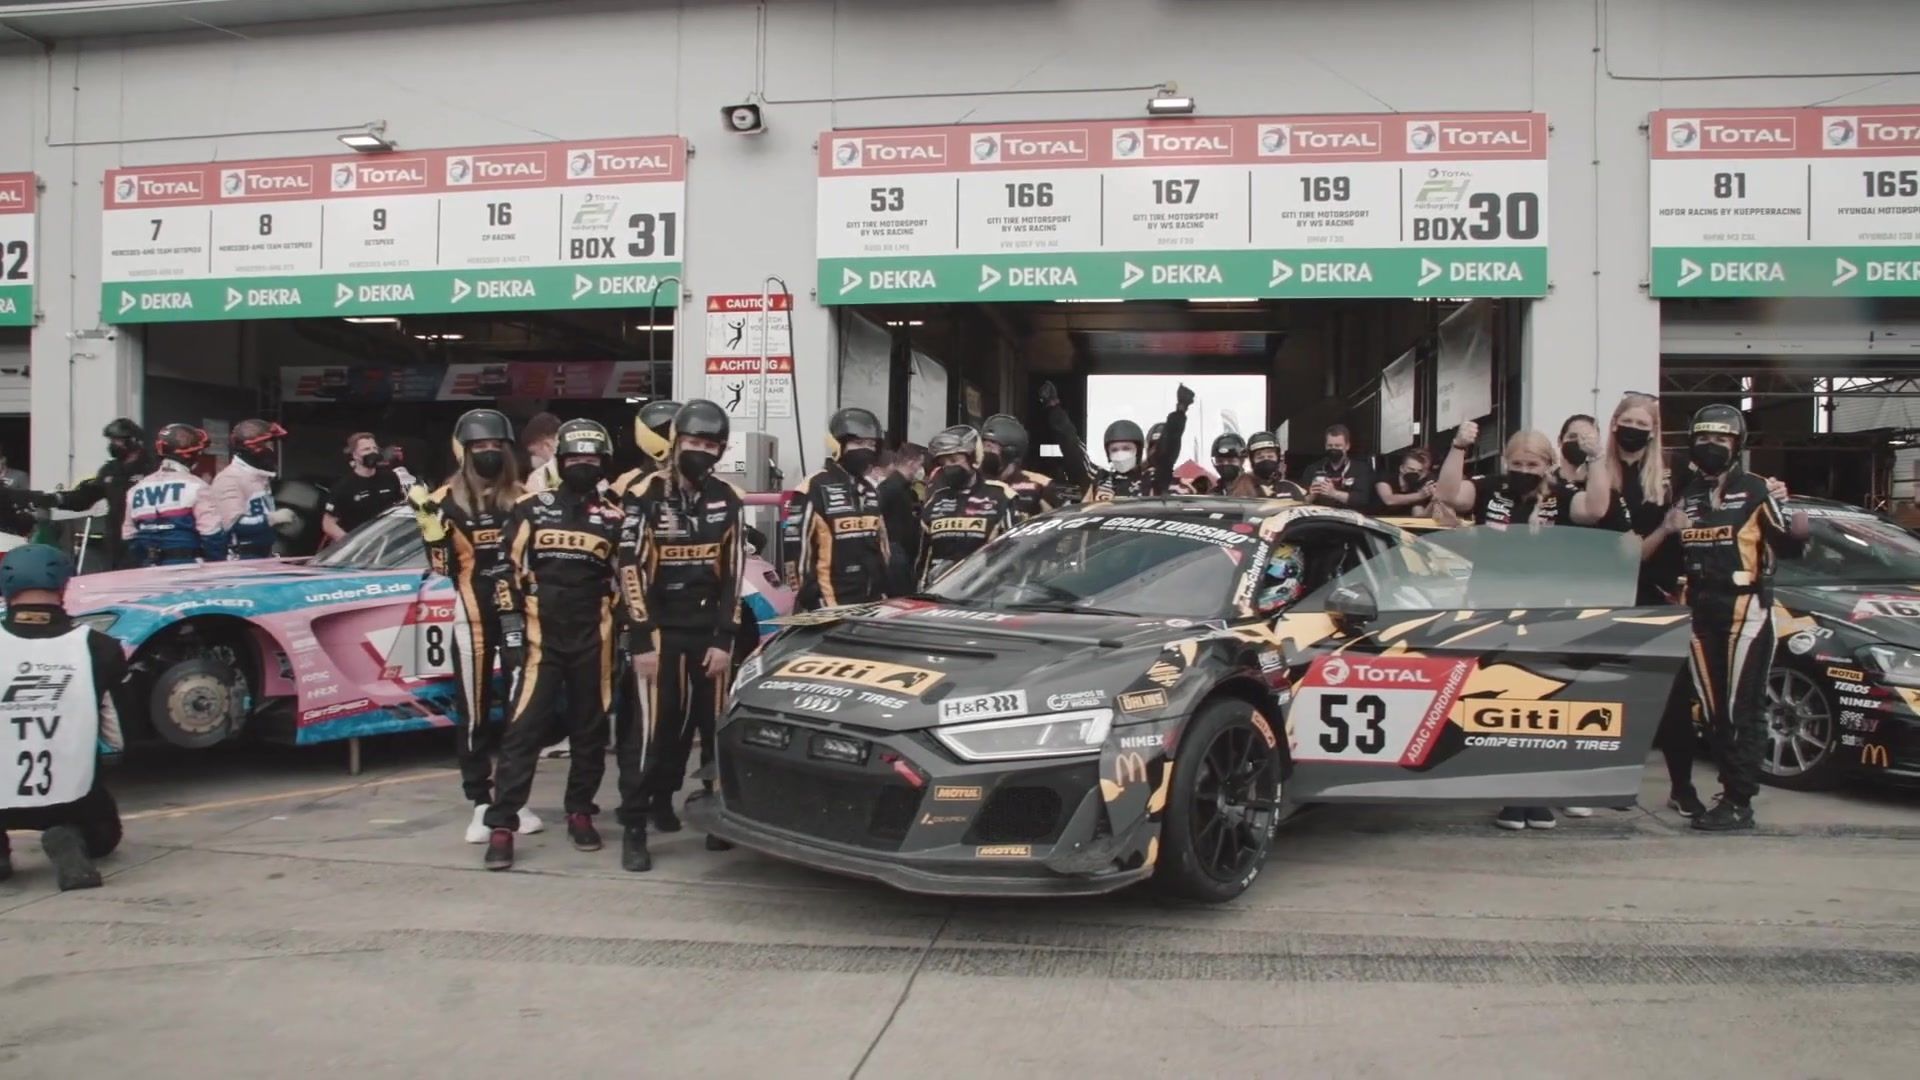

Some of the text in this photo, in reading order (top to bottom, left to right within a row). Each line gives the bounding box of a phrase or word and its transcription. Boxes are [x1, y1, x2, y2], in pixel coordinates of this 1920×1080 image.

[1147, 134, 1229, 151] TOTAL
[1294, 130, 1376, 148] TOTAL
[1443, 127, 1527, 145] TOTAL
[1704, 125, 1790, 144] TOTAL
[865, 143, 943, 161] TOTAL
[1004, 138, 1083, 157] TOTAL
[476, 160, 542, 177] TOTAL
[597, 153, 668, 171] TOTAL
[247, 174, 309, 190] TOTAL
[359, 167, 424, 183] TOTAL
[1441, 169, 1472, 177] TOTAL
[140, 180, 200, 195] TOTAL
[1152, 179, 1200, 204] 167
[1300, 176, 1350, 202] 169
[1714, 172, 1746, 198] 81
[1863, 171, 1918, 198] 165
[870, 187, 904, 212] 53
[1004, 182, 1054, 208] 166
[373, 208, 387, 231] 9
[487, 202, 512, 226] 16
[1021, 215, 1071, 224] MOTORSPORT
[1149, 213, 1165, 221] TIRE
[1168, 212, 1219, 220] MOTORSPORT
[1317, 210, 1369, 218] MOTORSPORT
[1413, 192, 1539, 241] BOX 30
[1659, 207, 1802, 216] HOFOR RACING BY KUEPPERRACING
[1838, 207, 1876, 215] HYUNDAI
[151, 218, 163, 241] 7
[259, 213, 272, 236] 8
[872, 228, 885, 236] WS
[886, 228, 914, 236] RACING
[879, 219, 928, 228] MOTORSPORT
[1028, 224, 1057, 232] RACING
[1175, 221, 1205, 229] RACING
[1325, 219, 1354, 227] RACING
[492, 233, 516, 241] RACING
[570, 212, 676, 260] BOX 31
[0, 240, 28, 280] 2
[869, 269, 936, 289] DEKRA
[1009, 266, 1077, 286] DEKRA
[1152, 264, 1223, 284] DEKRA
[1301, 262, 1373, 282] DEKRA
[1450, 261, 1523, 281] DEKRA
[1710, 262, 1785, 281] DEKRA
[359, 284, 415, 302] DEKRA
[477, 279, 536, 299] DEKRA
[599, 275, 661, 294] DEKRA
[141, 290, 193, 311] DEKRA
[248, 288, 301, 307] DEKRA
[720, 360, 778, 371] ACHTUG
[132, 482, 186, 509] BWT
[839, 519, 868, 530] Giti
[933, 520, 963, 531] Giti
[1103, 516, 1249, 544] GRAN TURISMO
[539, 533, 585, 546] Giti
[1178, 532, 1235, 549] SIMULATOR
[1683, 530, 1711, 540] Giti
[664, 548, 702, 558] Giti
[304, 582, 413, 603] under8.de
[160, 598, 255, 616] FALKEN
[922, 608, 1012, 622] NIMEX
[426, 625, 446, 668] 8
[35, 663, 77, 671] TOTAL
[788, 660, 875, 679] Giti
[1352, 663, 1431, 684] TOTAL
[1829, 668, 1862, 680] MOTUL
[758, 680, 909, 709] COMPETITION TIRES
[1834, 681, 1871, 695] TEROS
[944, 697, 989, 718] H&R
[1071, 697, 1100, 708] WORLD
[1406, 660, 1469, 763] ADAC NORDRHEIN
[1840, 696, 1881, 709] NIMEX
[10, 715, 62, 741] TV
[1318, 693, 1386, 755] 53
[1473, 708, 1560, 731] Giti
[1120, 734, 1164, 748] NIMEX
[1464, 735, 1622, 751] COMPETITION TIRES
[16, 749, 52, 796] 23
[937, 788, 979, 798] MOTUL
[980, 846, 1027, 855] MOTUL
